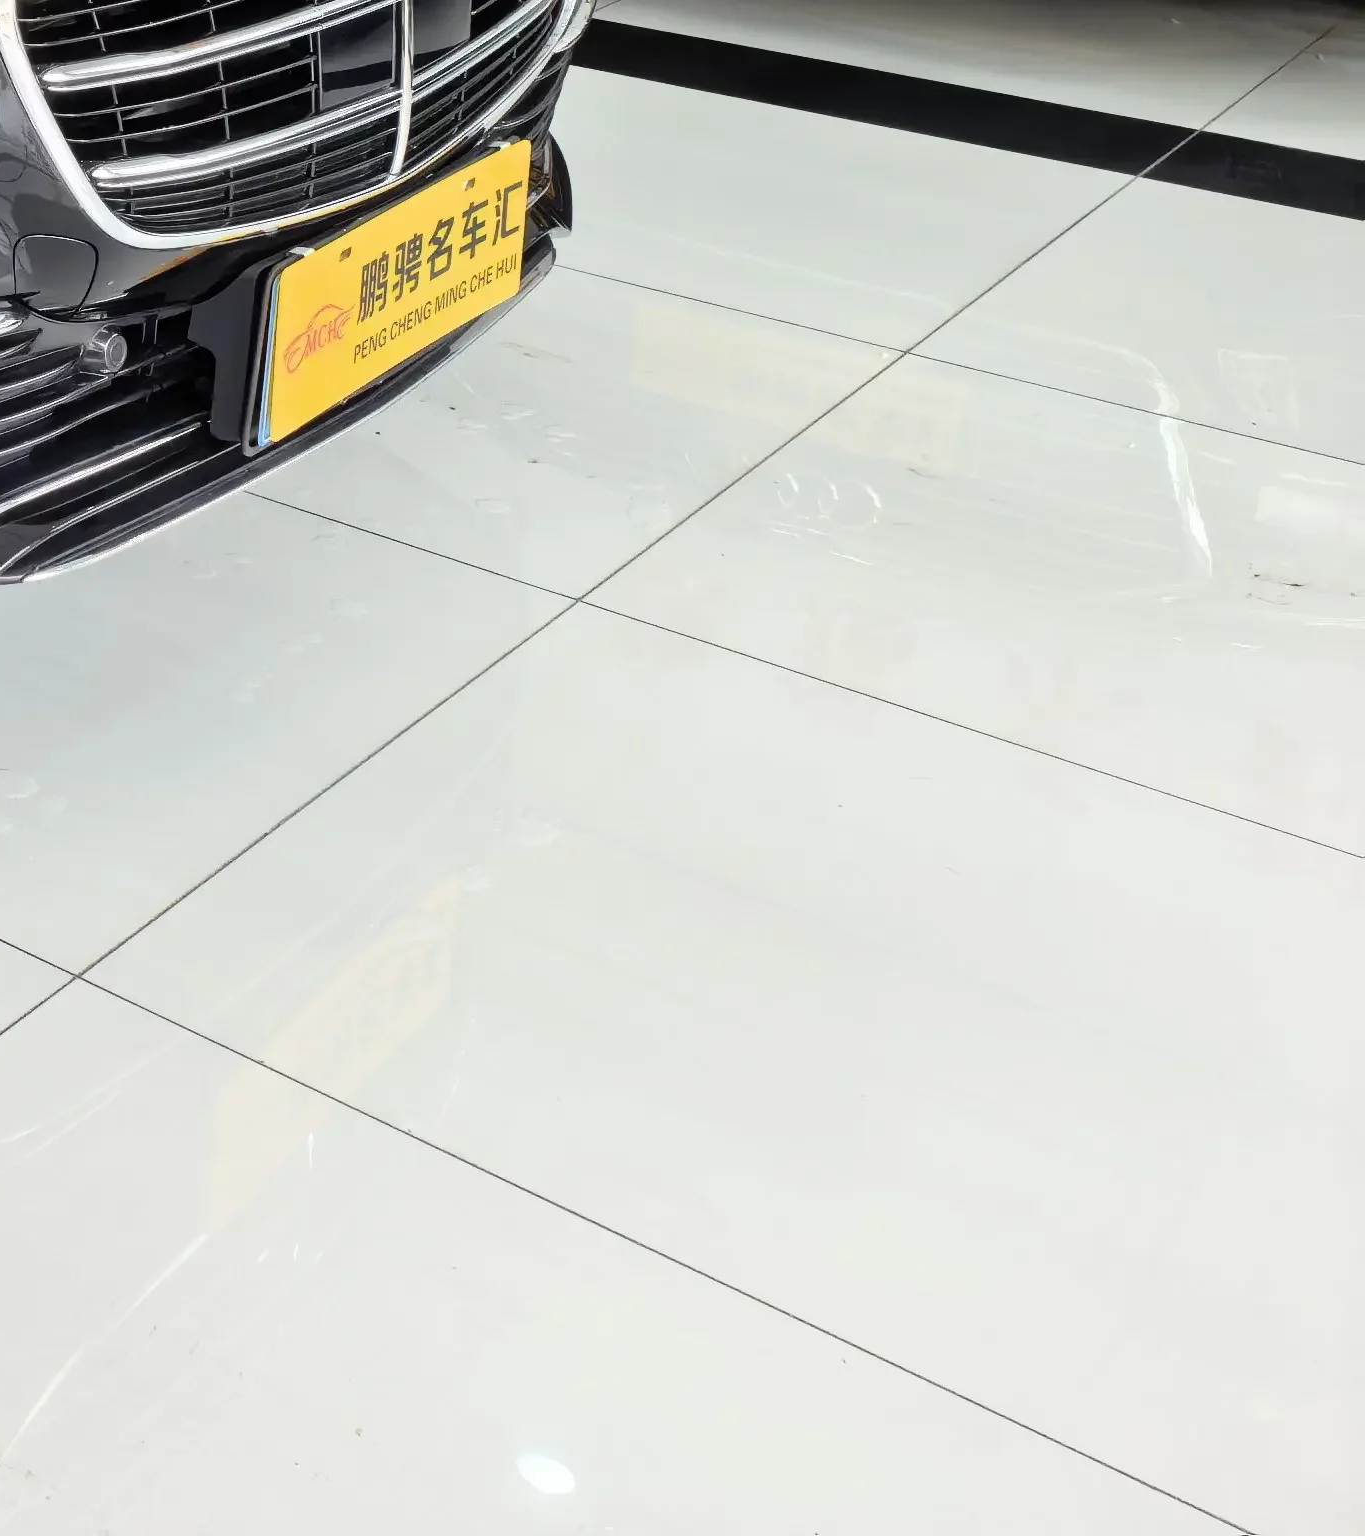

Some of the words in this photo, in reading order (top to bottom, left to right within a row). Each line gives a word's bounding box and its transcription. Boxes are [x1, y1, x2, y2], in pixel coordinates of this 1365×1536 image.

[353, 328, 387, 364] PENG
[390, 300, 432, 341] CHENG
[434, 280, 467, 314] MING
[469, 265, 493, 293] CHE
[495, 253, 517, 279] HUI
[356, 180, 523, 326] 鹏骋名车汇
